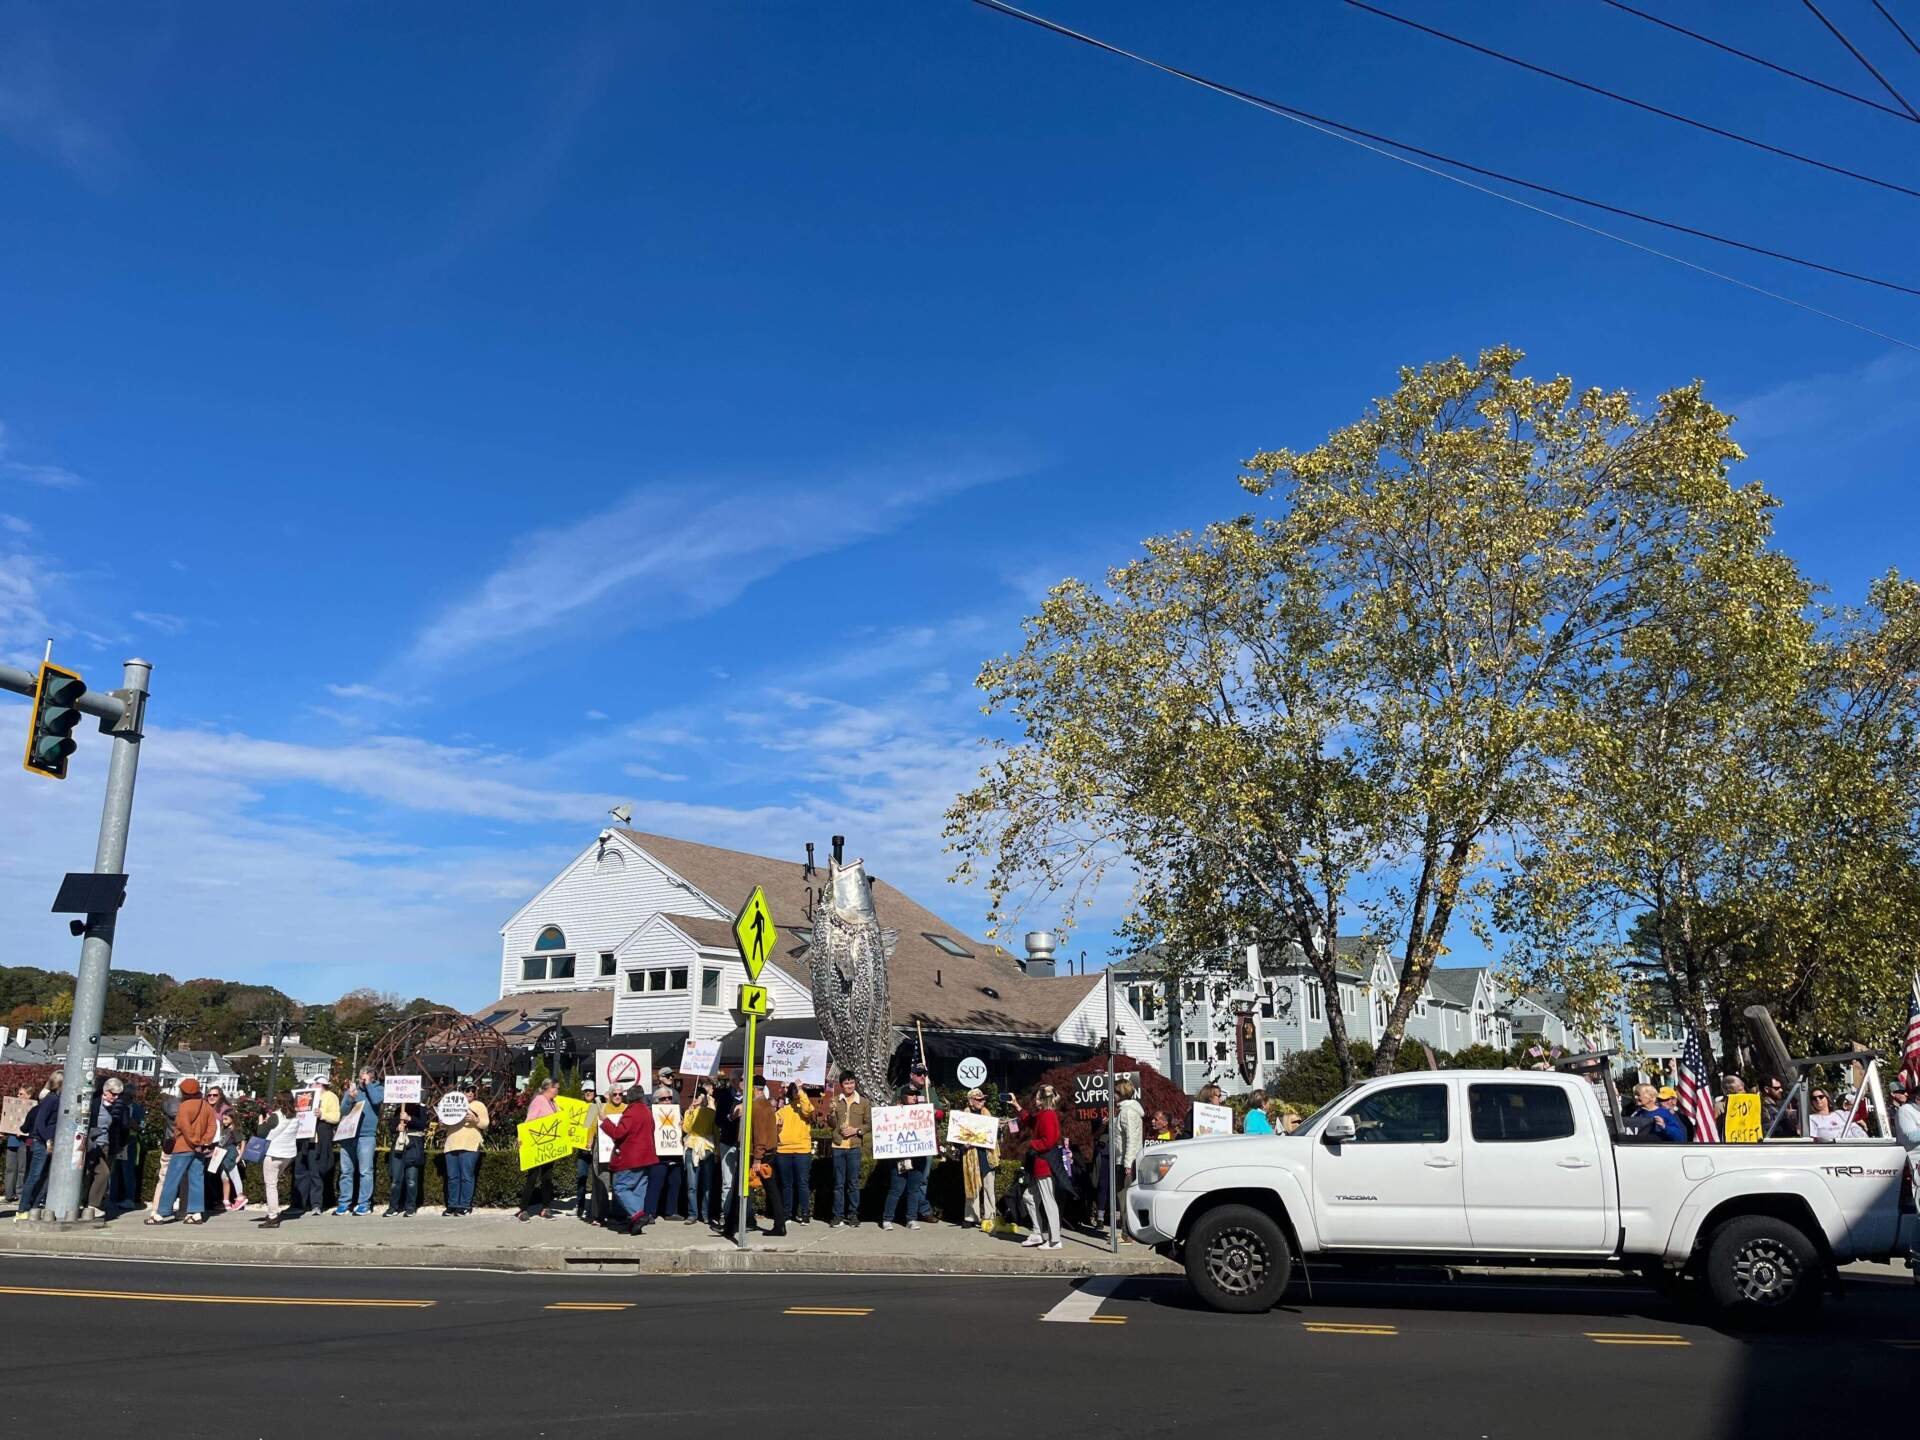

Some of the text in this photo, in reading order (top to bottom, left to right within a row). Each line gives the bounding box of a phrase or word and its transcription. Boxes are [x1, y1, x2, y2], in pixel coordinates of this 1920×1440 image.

[772, 1040, 786, 1048] FOR
[960, 1065, 986, 1079] S&P
[1077, 1072, 1131, 1090] VOER
[909, 1109, 932, 1120] NOT
[1080, 1108, 1098, 1120] THIS
[1730, 1100, 1752, 1117] STOP
[662, 1130, 677, 1140] NO
[897, 1130, 918, 1143] AM
[537, 1143, 554, 1155] NO
[661, 1140, 677, 1149] KINGS
